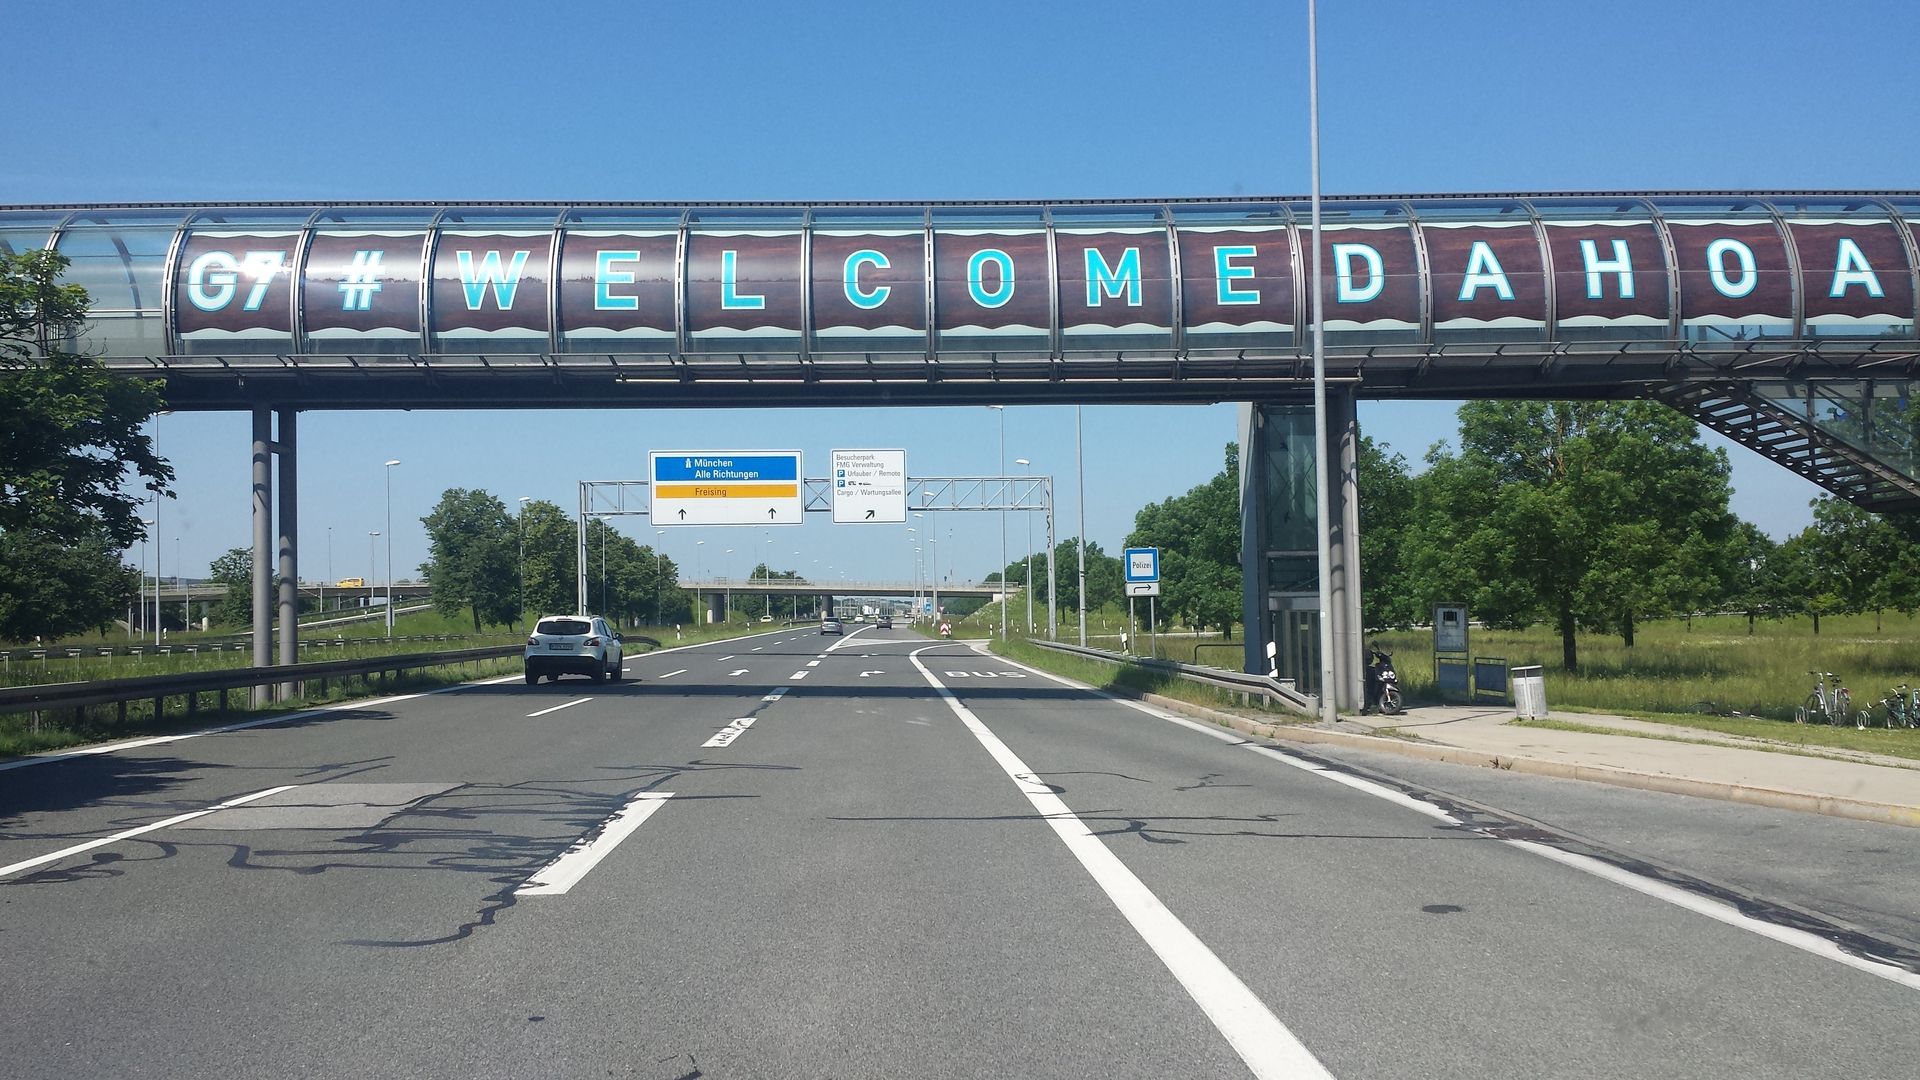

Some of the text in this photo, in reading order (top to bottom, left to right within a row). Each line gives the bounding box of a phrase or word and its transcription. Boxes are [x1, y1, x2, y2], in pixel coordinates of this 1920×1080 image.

[836, 454, 875, 462] Besucherpark
[694, 458, 733, 468] München
[695, 469, 759, 480] Alle Richtungen
[695, 488, 727, 498] Freising
[836, 489, 854, 497] Cargo
[860, 489, 902, 497] Wartungsallee
[1132, 561, 1152, 569] Polizei
